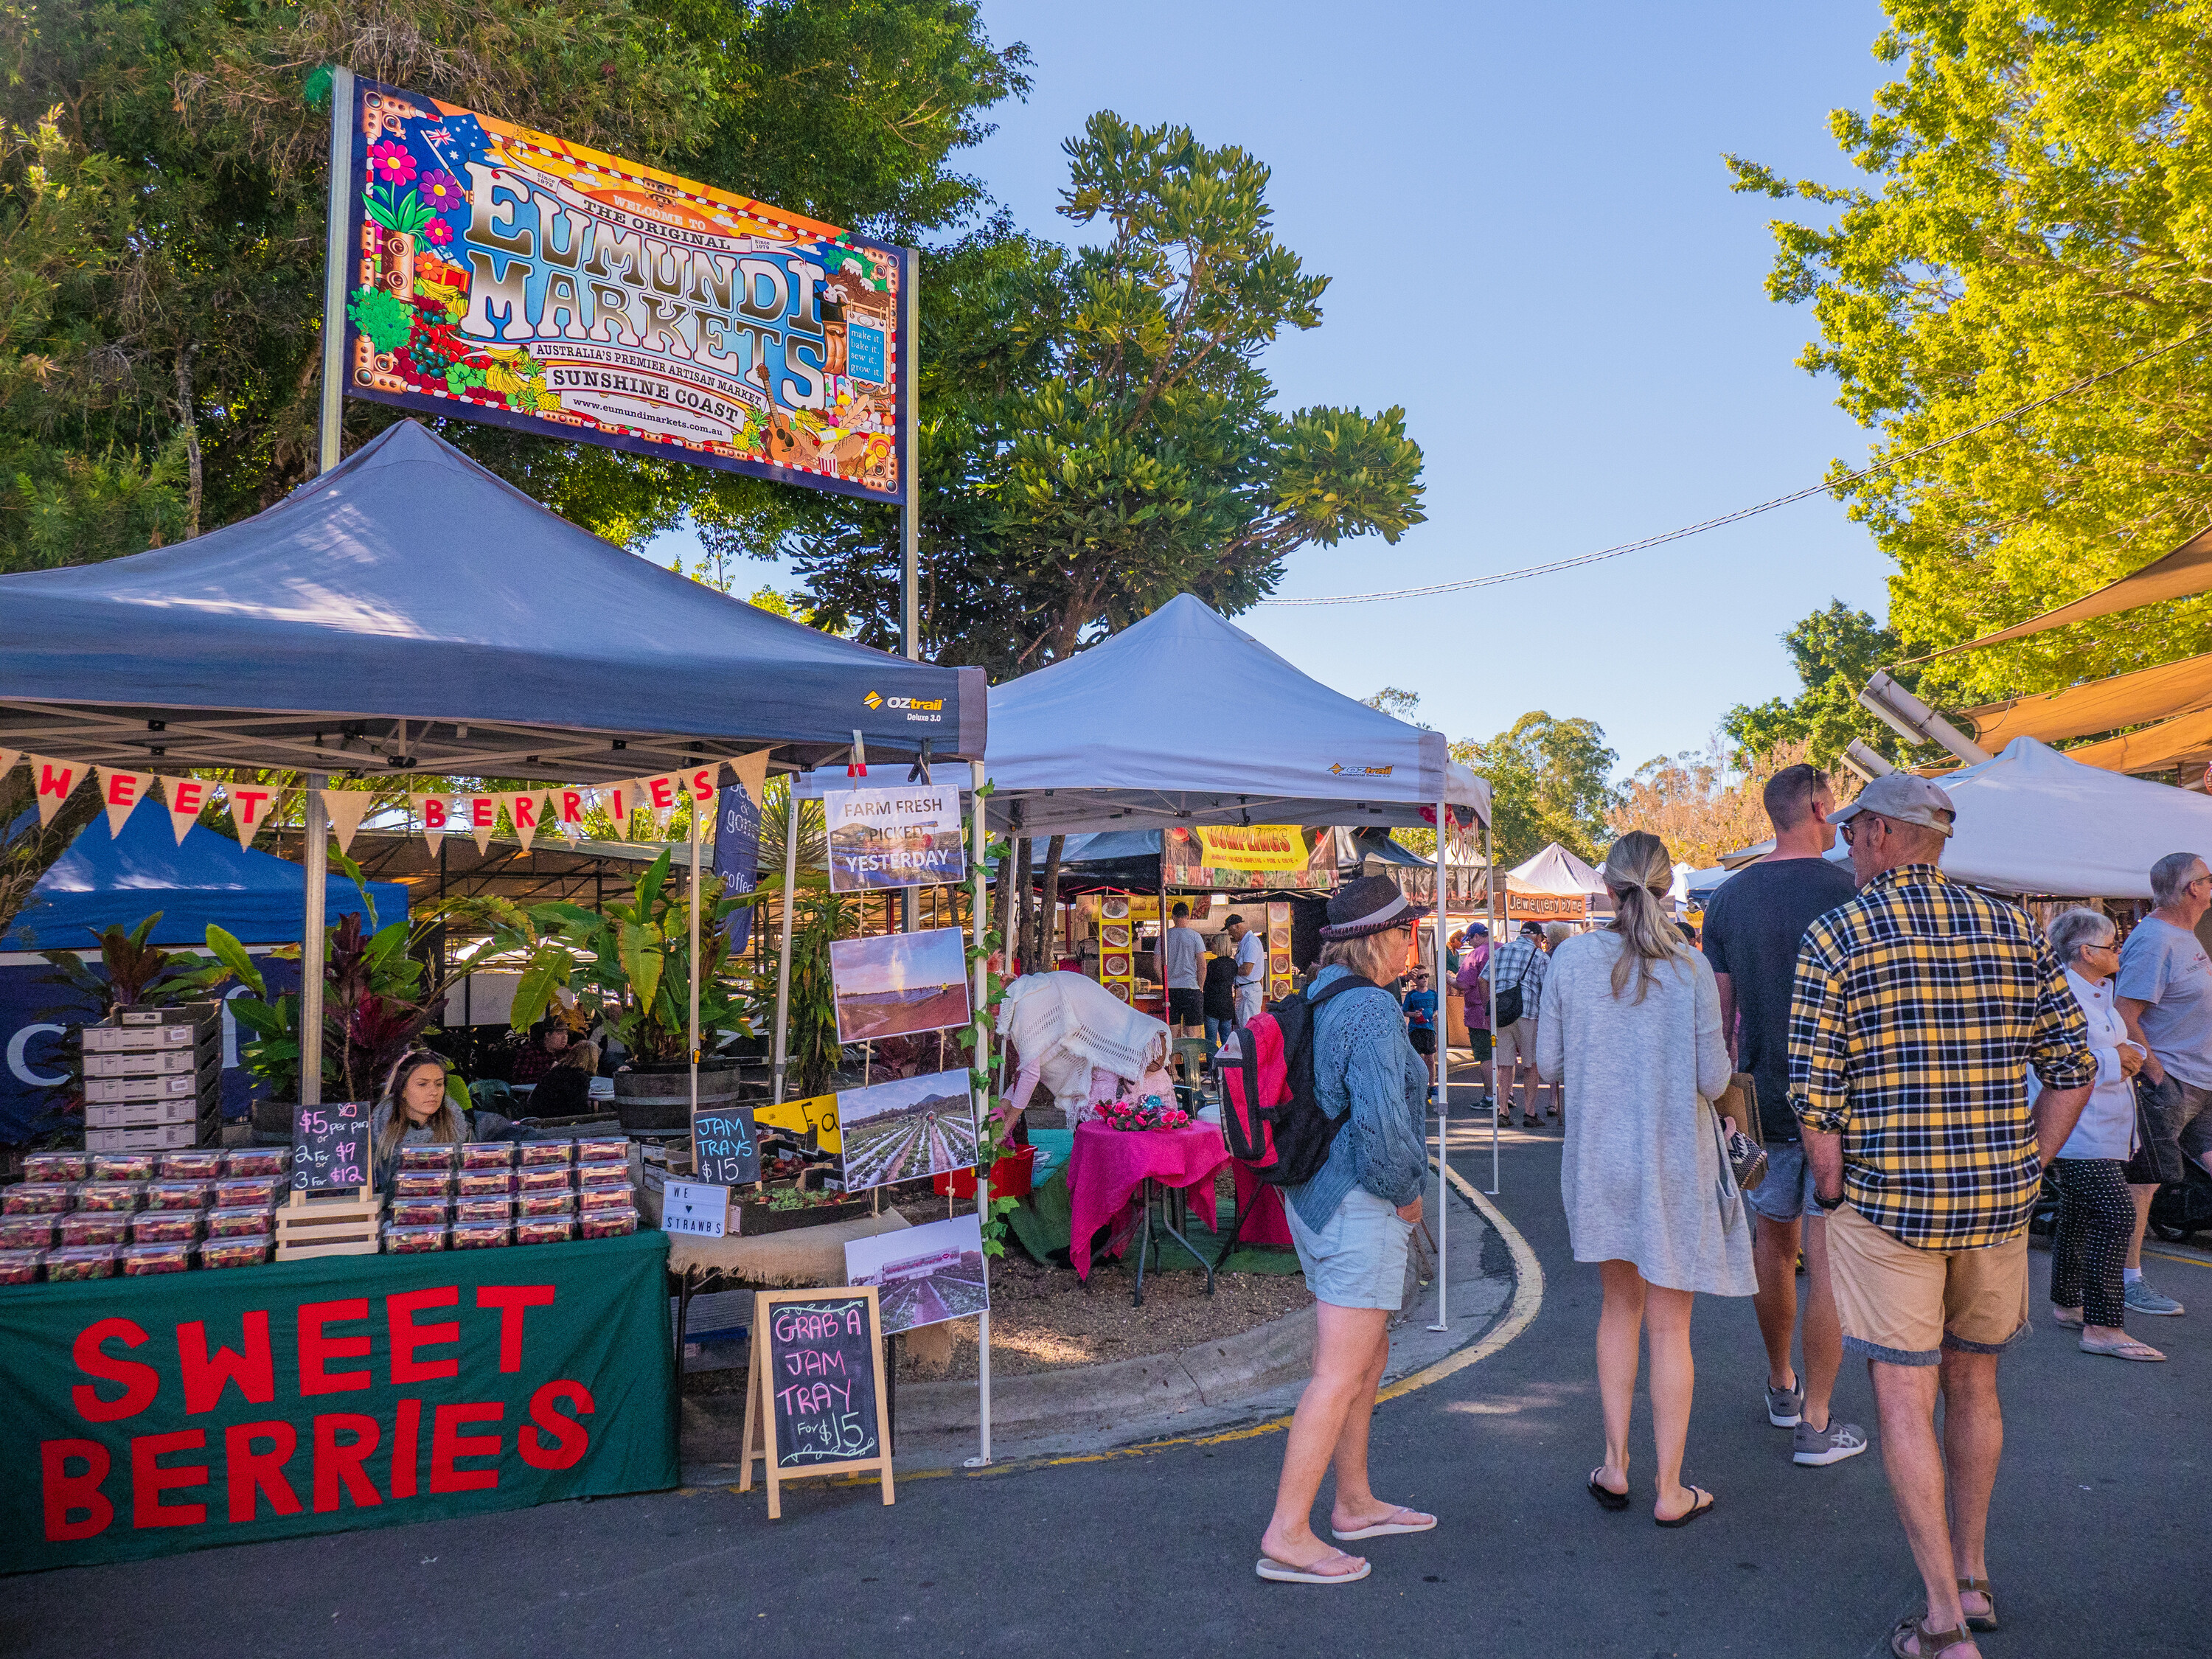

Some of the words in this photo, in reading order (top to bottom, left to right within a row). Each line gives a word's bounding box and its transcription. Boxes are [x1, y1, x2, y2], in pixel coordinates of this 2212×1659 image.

[536, 177, 554, 188] 1979
[538, 172, 555, 184] Since
[583, 199, 626, 224] THE
[632, 217, 730, 250] ORIGINAL
[613, 195, 683, 225] WELCOME
[689, 218, 706, 231] TO
[465, 162, 824, 334] EUMUNDI
[460, 252, 826, 408] MARKETS
[851, 330, 871, 341] make
[874, 335, 882, 344] it.
[851, 338, 869, 351] bake
[872, 346, 880, 355] it.
[851, 353, 866, 361] sew
[869, 355, 877, 364] it.
[537, 344, 612, 361] AUSTRALIA'S
[614, 354, 667, 372] PREMIER
[668, 365, 715, 386] ARTISAN
[717, 381, 762, 406] MARKET
[851, 364, 870, 374] grow
[874, 369, 882, 378] it.
[553, 370, 669, 400] SUNSHINE
[675, 389, 738, 423] COAST
[573, 398, 723, 437] www.eumundimarkets.com.au
[887, 697, 942, 711] OZtrail
[907, 713, 929, 721] Deluxe
[1346, 765, 1392, 774] OZtrail
[0, 756, 268, 824] WEET
[425, 771, 714, 828] BERRIES
[844, 801, 891, 817] FARM
[896, 798, 942, 813] FRESH
[869, 825, 922, 841] PICKED
[1207, 825, 1291, 852] DUMPLINGS
[846, 849, 949, 873] YESTERDAY
[1510, 894, 1559, 914] Jewellery
[1561, 898, 1571, 913] by
[1572, 900, 1582, 912] me
[299, 1110, 328, 1133] $5
[330, 1123, 347, 1135] per
[696, 1117, 745, 1139] JAM
[317, 1135, 329, 1143] or
[697, 1140, 753, 1157] TRAYS
[295, 1145, 313, 1163] 2
[335, 1142, 356, 1162] $9
[294, 1171, 308, 1189] 3
[330, 1166, 366, 1182] $12
[701, 1158, 739, 1183] $15
[674, 1186, 689, 1199] WE
[667, 1217, 721, 1234] STRAWBS
[776, 1312, 838, 1342] GRAB
[847, 1310, 861, 1335] A
[72, 1284, 556, 1422] SWEET
[785, 1349, 846, 1376] JAM
[776, 1379, 851, 1416] TRAY
[818, 1411, 863, 1448] $15
[40, 1380, 595, 1543] BERRIES
